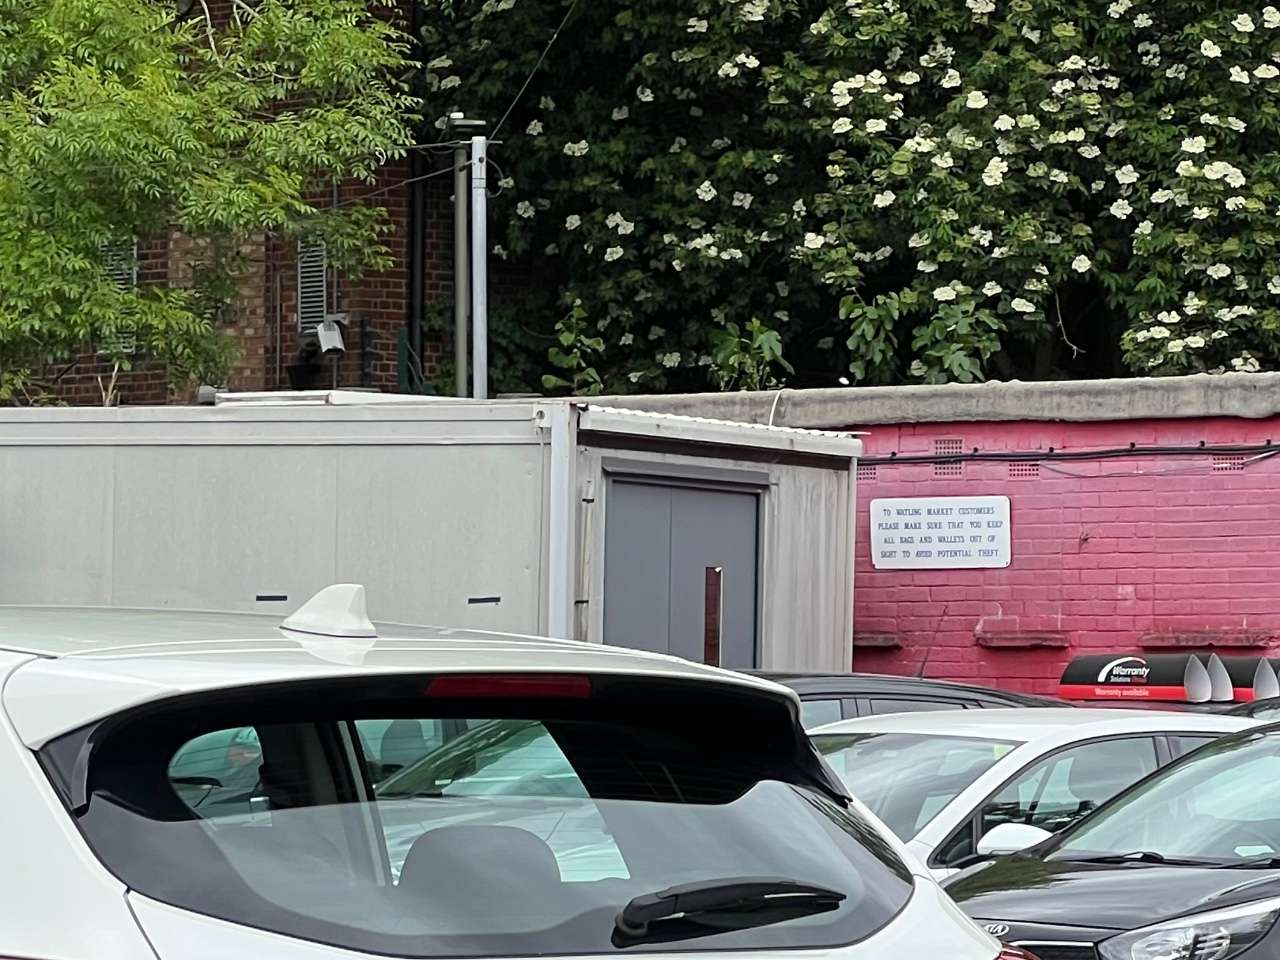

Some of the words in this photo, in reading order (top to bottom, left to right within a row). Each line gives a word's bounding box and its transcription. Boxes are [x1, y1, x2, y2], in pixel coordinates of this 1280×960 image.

[920, 536, 932, 544] AND
[902, 550, 911, 558] TO
[978, 549, 999, 557] THEFT
[1113, 666, 1149, 677] Warranty
